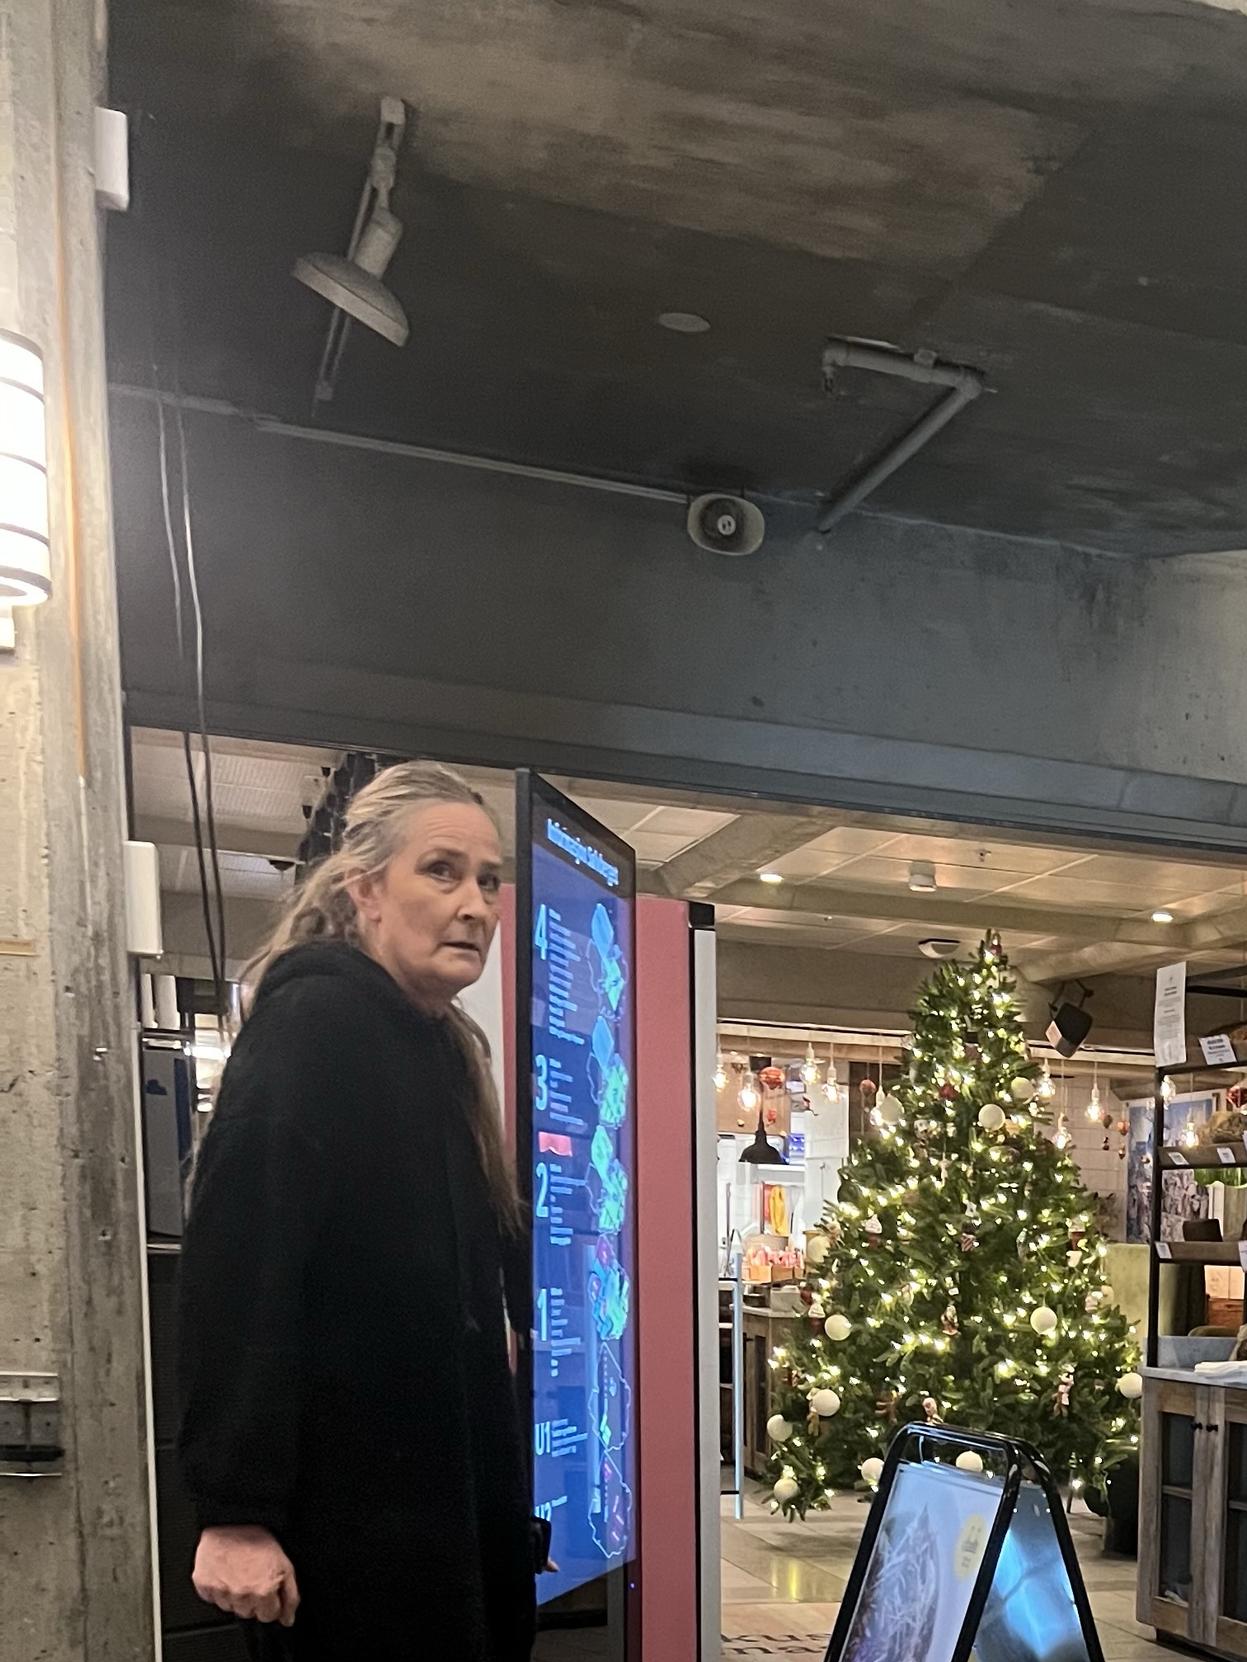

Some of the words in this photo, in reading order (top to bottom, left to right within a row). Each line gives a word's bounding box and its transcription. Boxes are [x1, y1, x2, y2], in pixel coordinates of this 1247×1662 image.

[534, 903, 548, 960] 4
[535, 1054, 549, 1111] 3
[536, 1163, 549, 1218] 2
[536, 1288, 548, 1342] 1
[535, 1421, 551, 1456] U1
